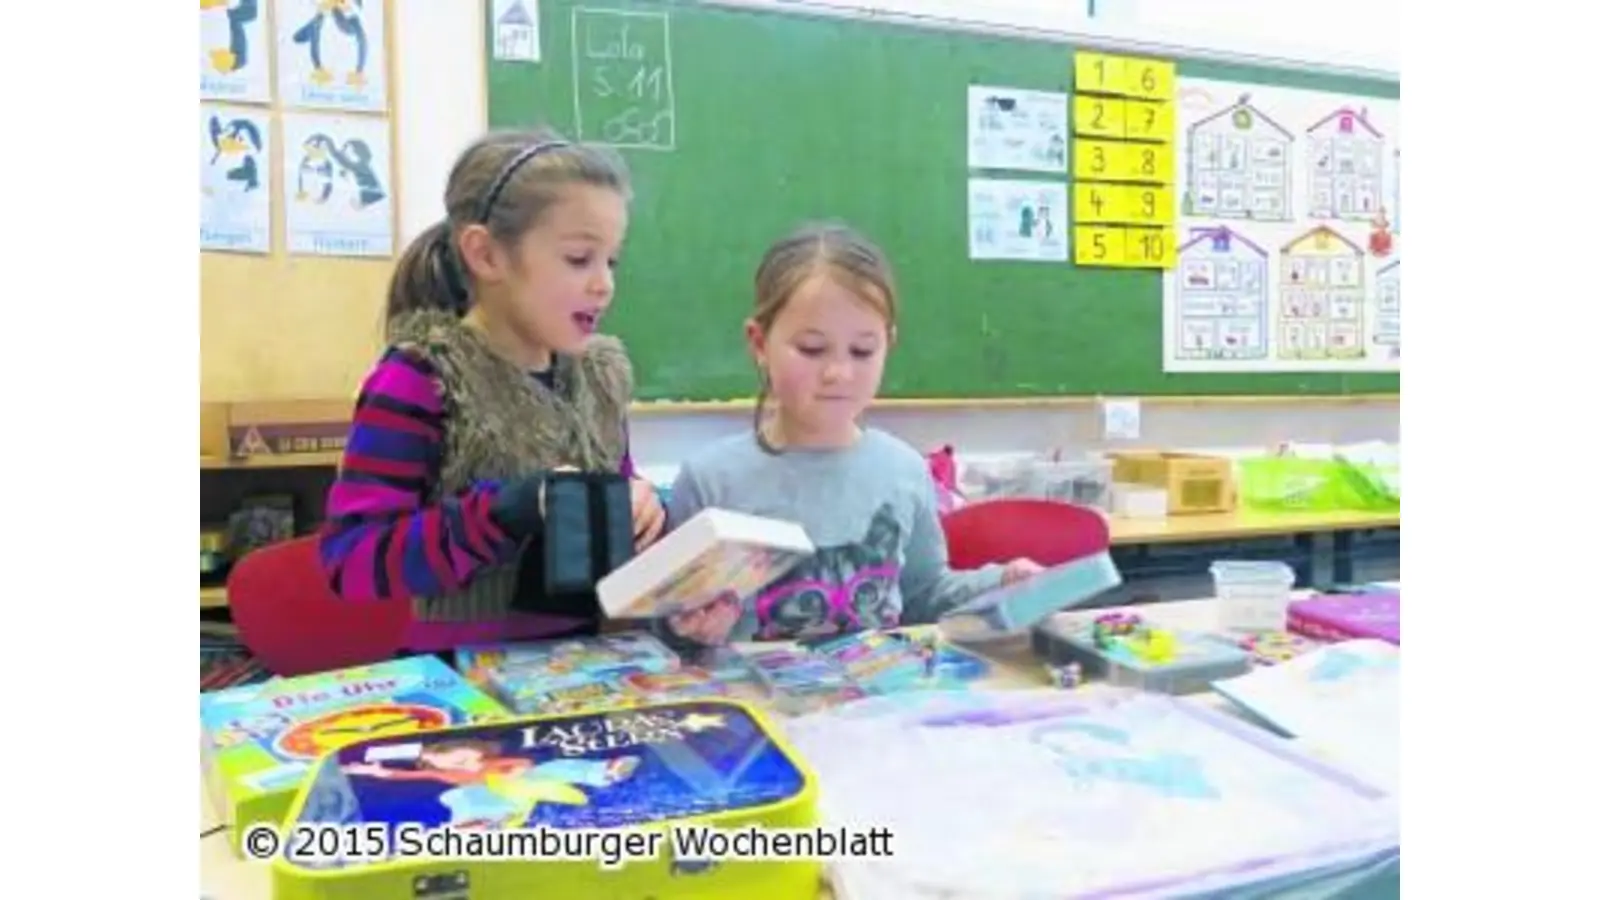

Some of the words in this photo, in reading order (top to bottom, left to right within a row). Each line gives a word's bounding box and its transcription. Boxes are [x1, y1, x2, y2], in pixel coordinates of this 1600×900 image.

[1092, 59, 1104, 87] 1
[1141, 66, 1156, 92] 6
[1090, 102, 1107, 129] 2
[1143, 106, 1155, 133] 7
[1090, 146, 1106, 172] 3
[1141, 148, 1155, 175] 8
[1089, 189, 1105, 216] 4
[1141, 191, 1155, 218] 9
[1093, 233, 1106, 260] 5
[1139, 233, 1164, 262] 10
